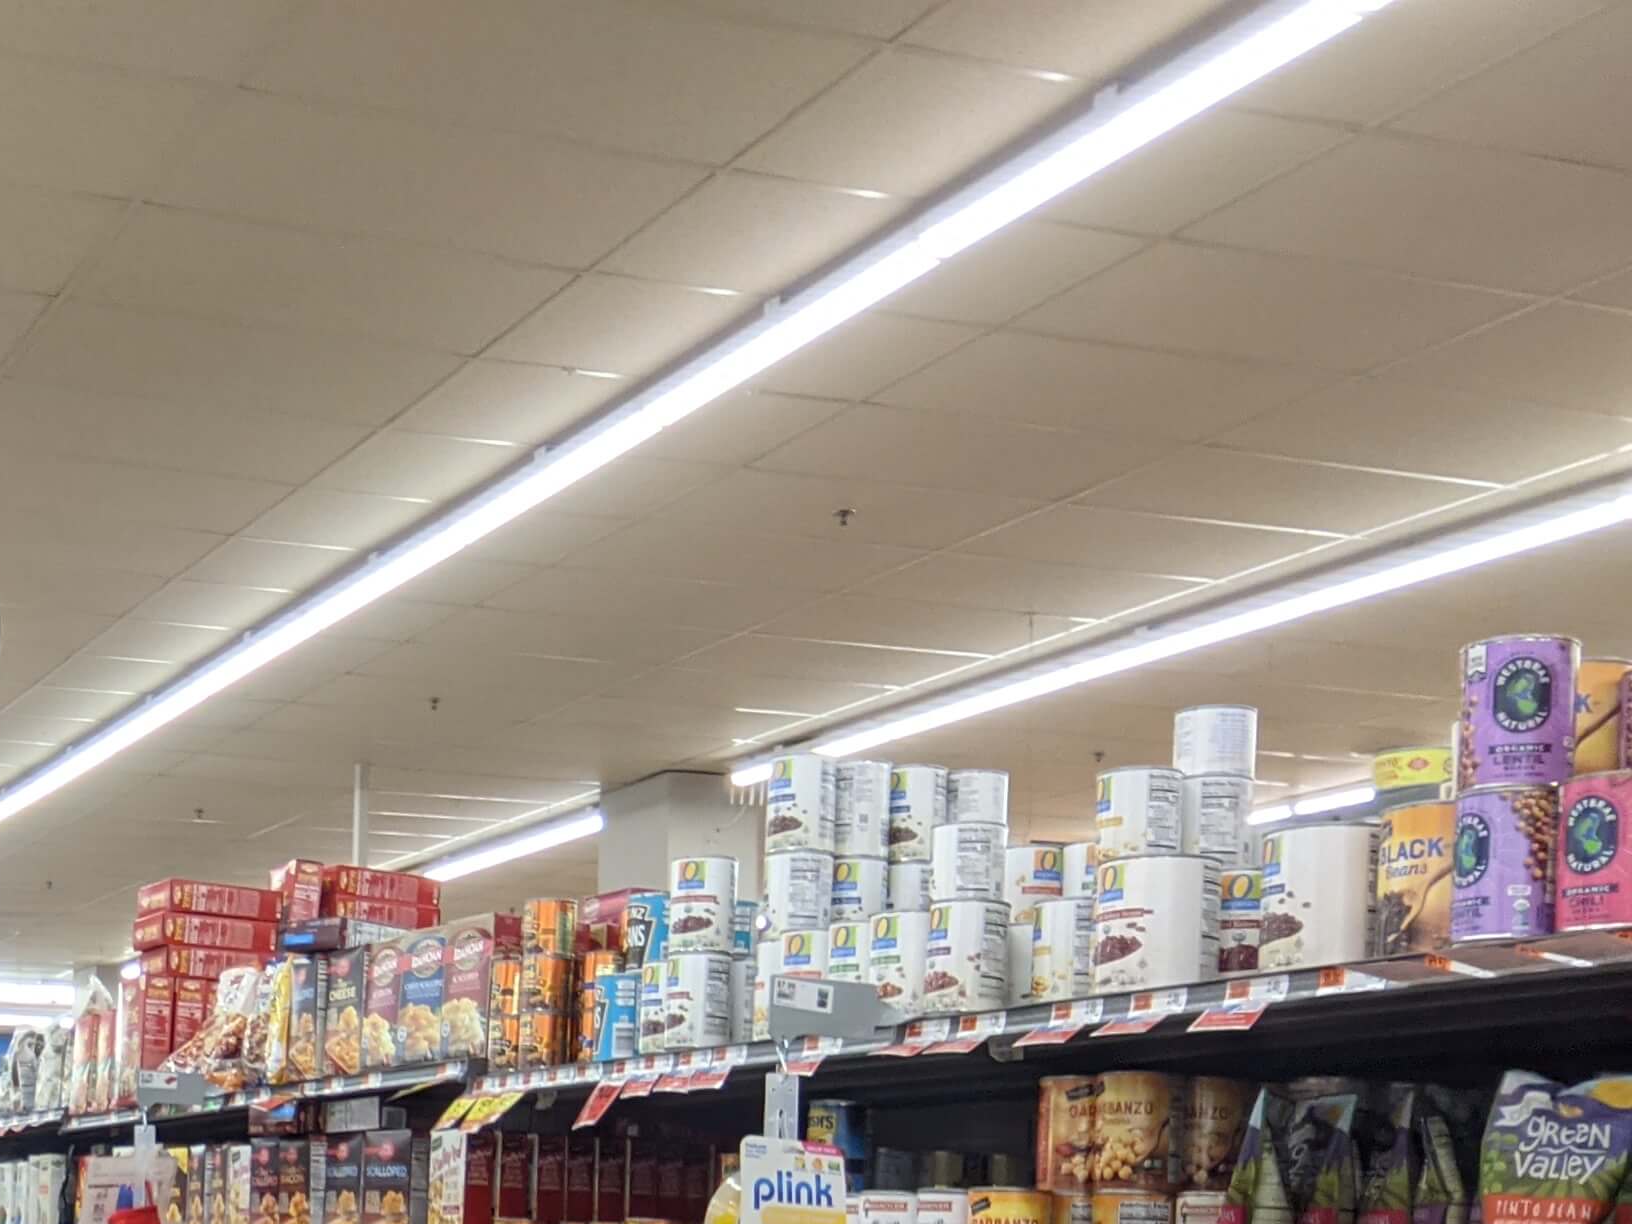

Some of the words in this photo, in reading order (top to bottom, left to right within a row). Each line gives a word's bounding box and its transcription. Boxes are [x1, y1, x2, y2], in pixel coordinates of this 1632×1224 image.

[1496, 711, 1548, 731] NATURAL
[753, 1168, 833, 1210] plink
[1546, 1202, 1592, 1222] BEAN
